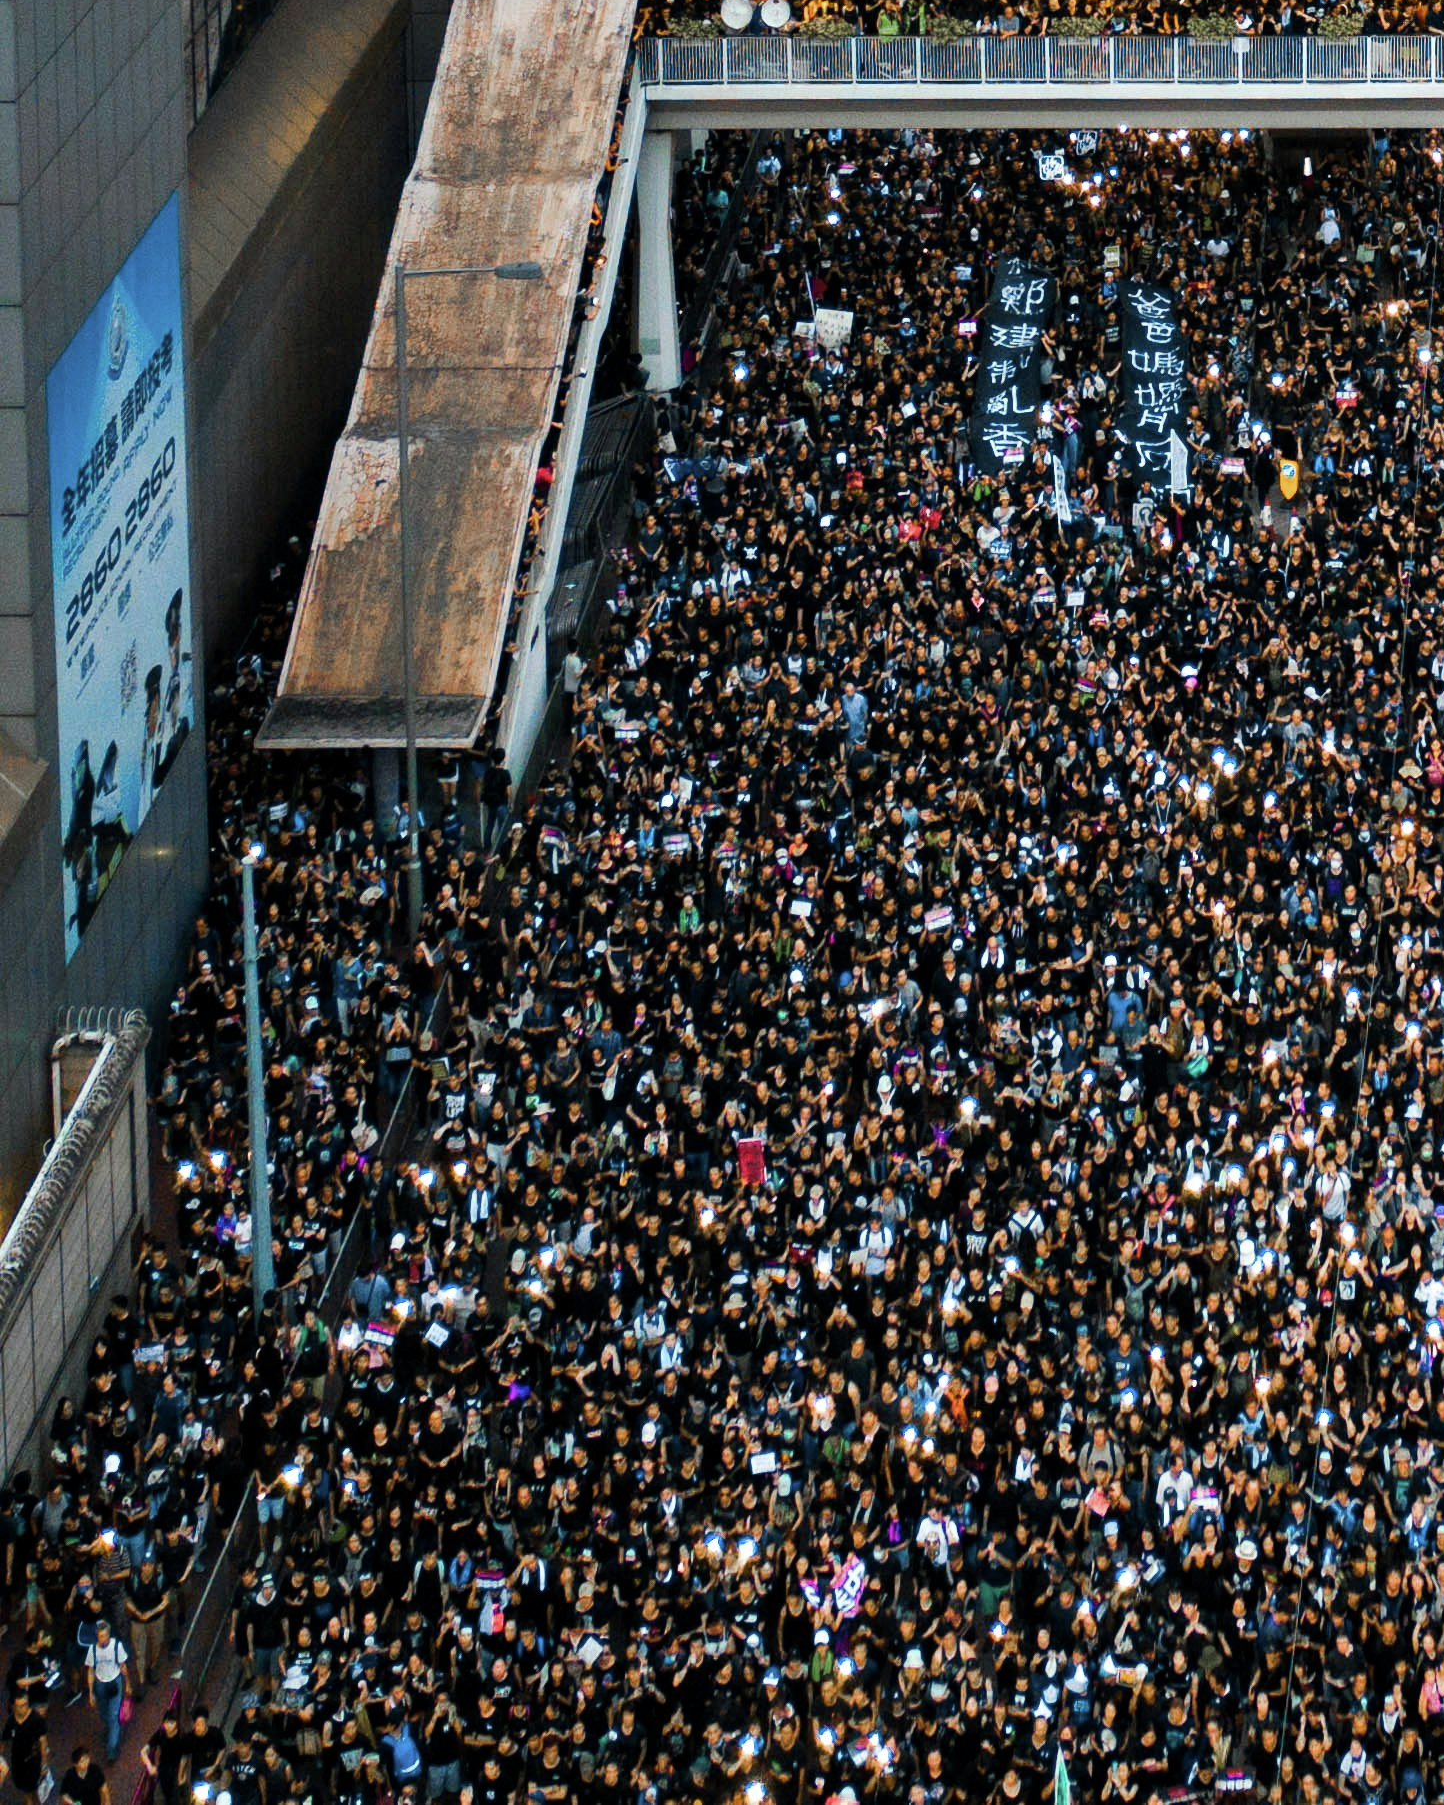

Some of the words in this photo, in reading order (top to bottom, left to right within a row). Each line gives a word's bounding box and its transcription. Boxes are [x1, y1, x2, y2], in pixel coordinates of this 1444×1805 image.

[60, 410, 118, 541] 全年招募
[120, 325, 173, 447] 請即投考
[65, 520, 121, 646] 2860
[124, 430, 176, 547] 2860
